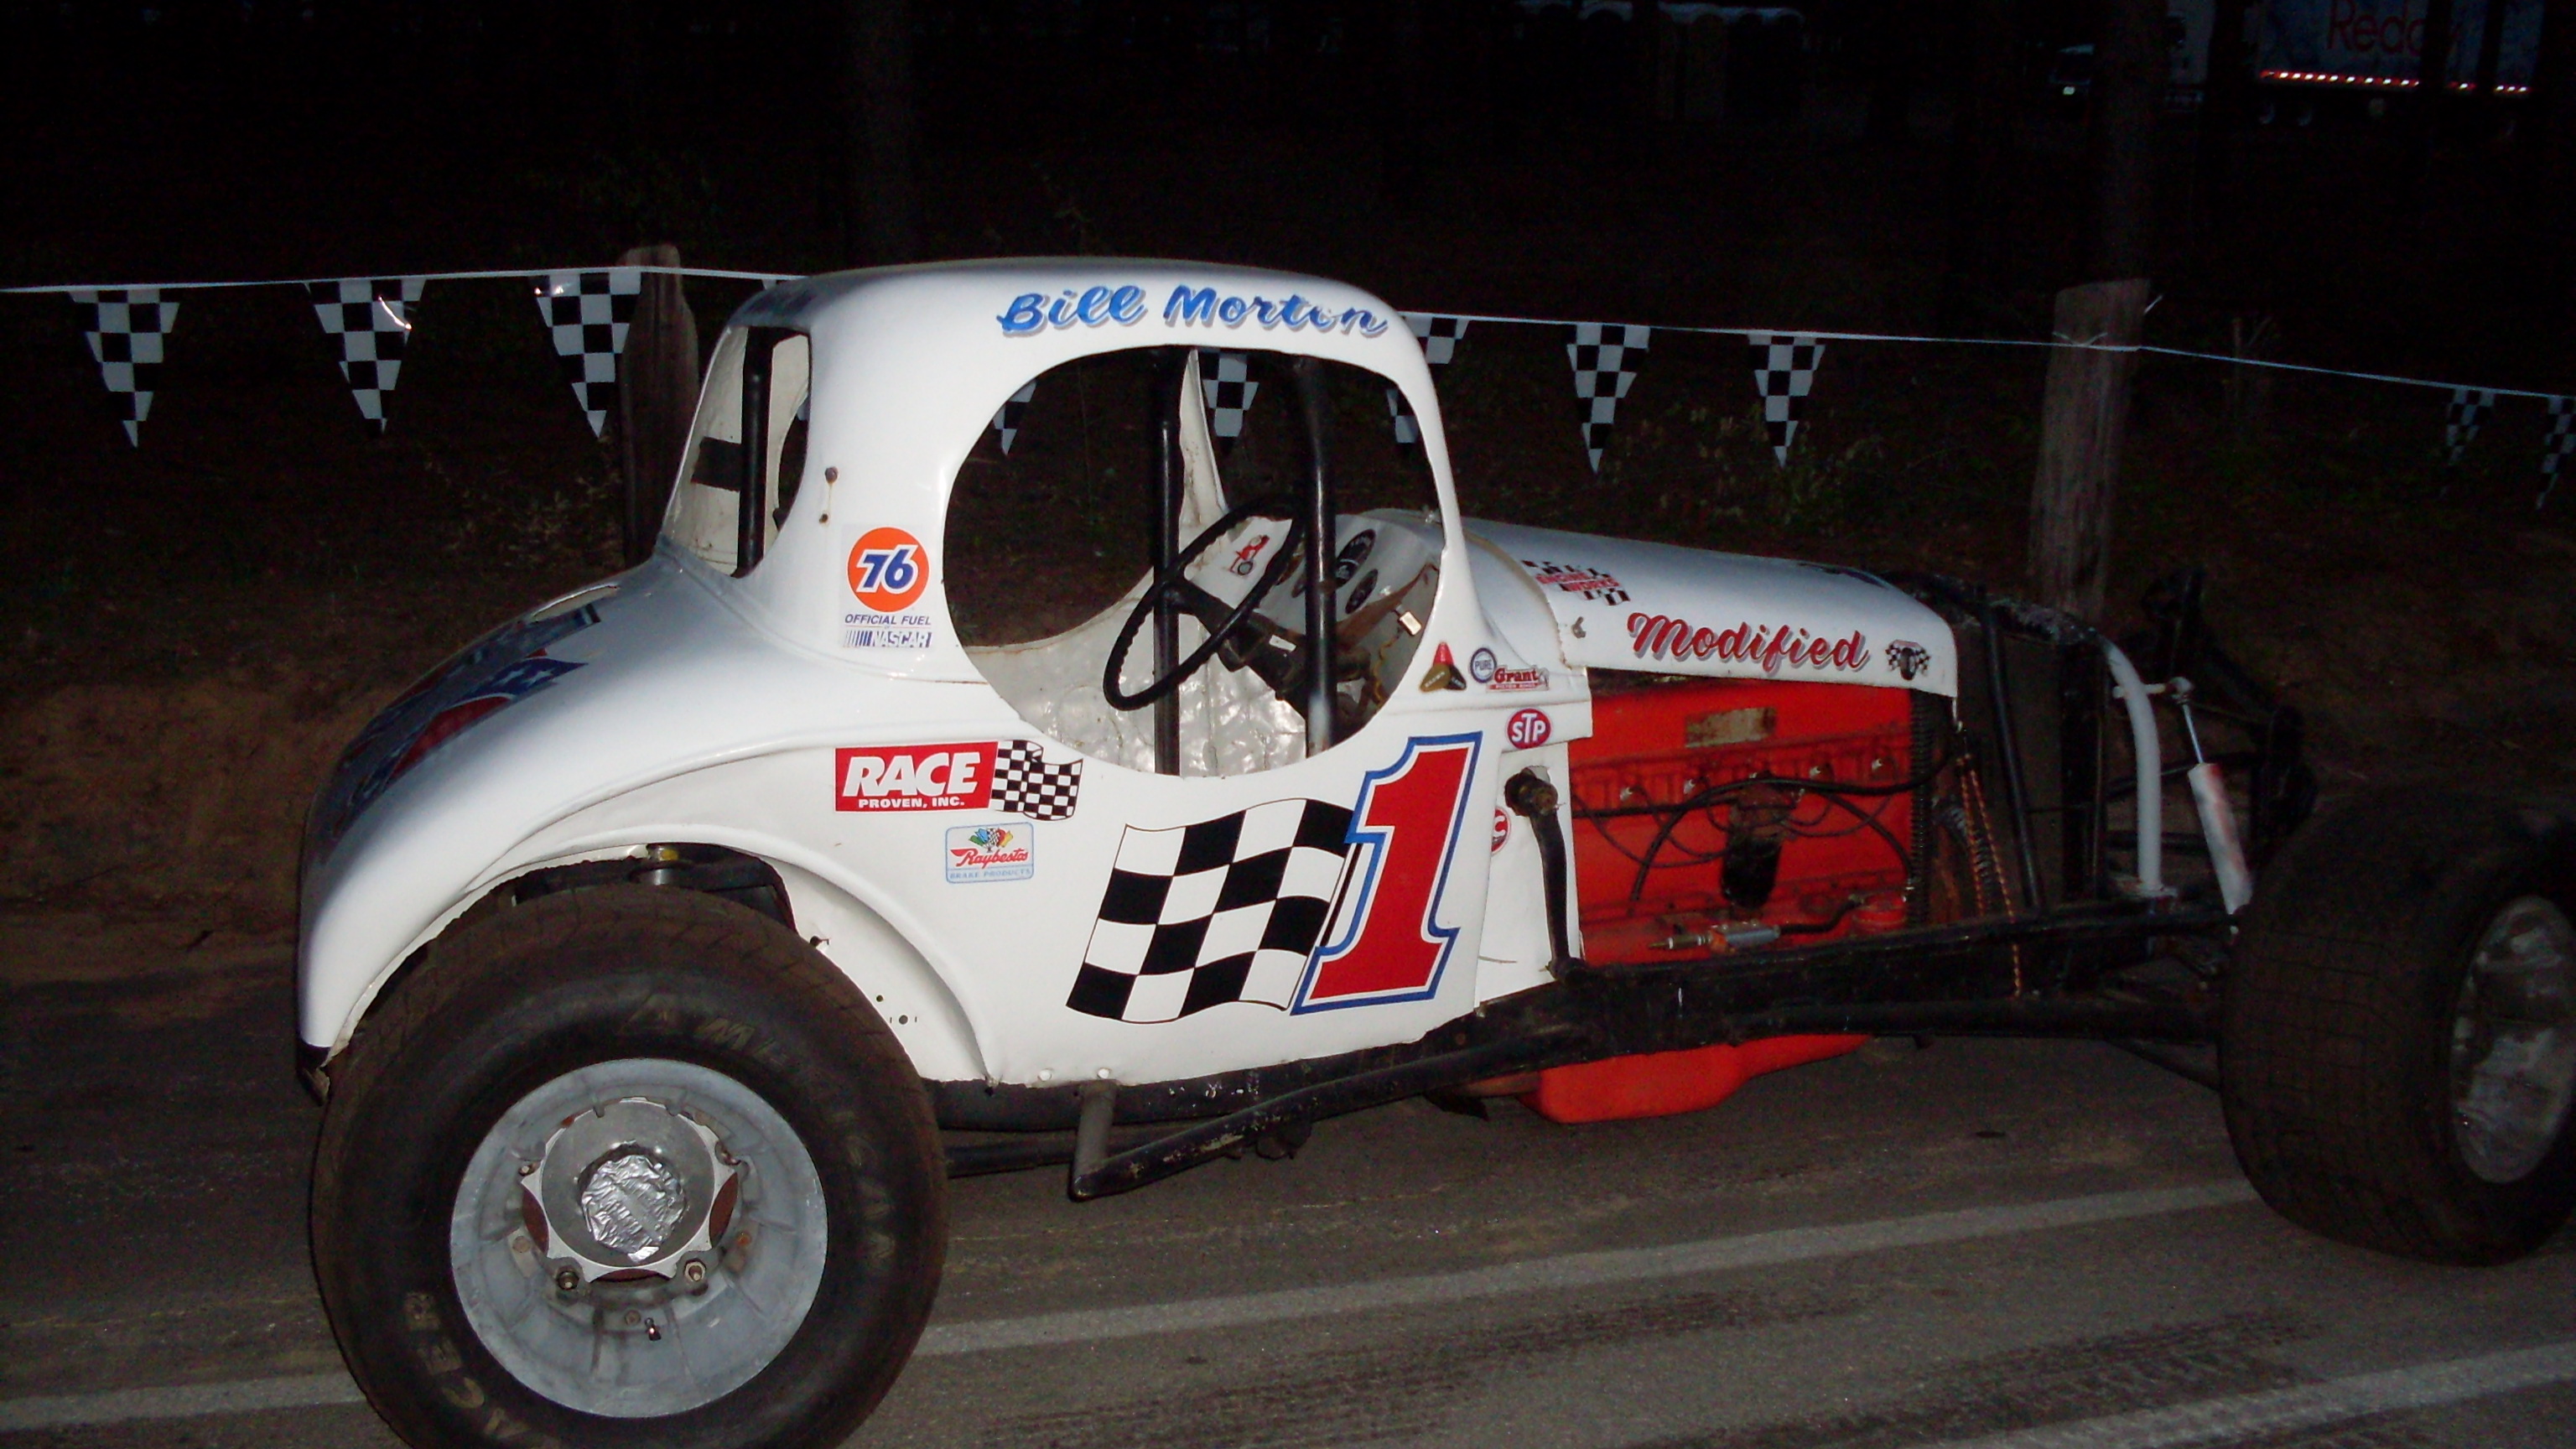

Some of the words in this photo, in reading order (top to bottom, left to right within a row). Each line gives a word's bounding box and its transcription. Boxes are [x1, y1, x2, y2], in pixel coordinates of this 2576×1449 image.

[996, 284, 1145, 336] Bill
[856, 544, 919, 595] 76
[844, 614, 896, 625] OFFICIAL
[901, 615, 932, 626] FUEL
[872, 631, 932, 648] NASCAR
[1627, 611, 1871, 676] Modified
[1473, 659, 1493, 671] PURE
[1493, 667, 1540, 683] Grant
[1511, 713, 1546, 744] STP
[842, 751, 981, 797] RACE
[858, 797, 927, 809] PROVEN,
[932, 797, 965, 808] INC.
[949, 847, 1030, 870] Raybestos
[984, 868, 1032, 878] PRODUCTS
[1290, 730, 1483, 1015] 1
